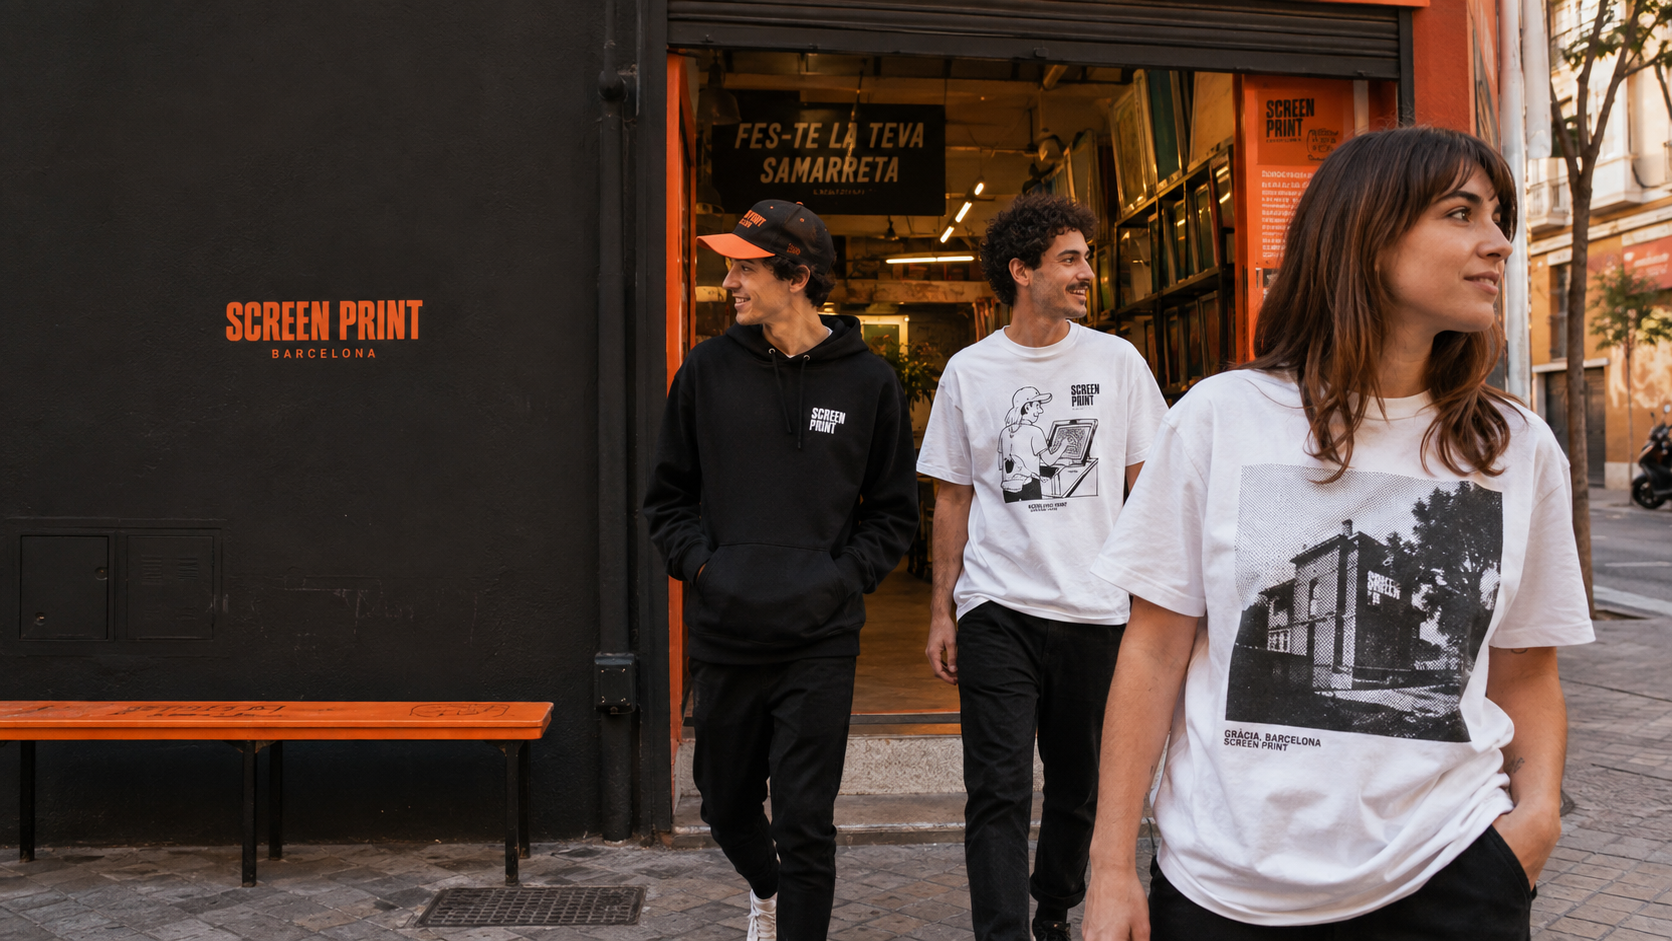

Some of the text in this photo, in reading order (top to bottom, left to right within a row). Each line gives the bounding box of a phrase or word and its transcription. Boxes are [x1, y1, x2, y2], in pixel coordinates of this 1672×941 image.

[1266, 98, 1315, 118] SCREEN
[734, 122, 924, 149] FES-TE LA TEVA
[1266, 118, 1304, 138] PRINT
[760, 156, 899, 183] SAMARRETA
[225, 300, 423, 342] SCREEN PRINT
[271, 348, 376, 359] BARCELONA
[1070, 384, 1100, 395] SCREEN
[1071, 395, 1094, 407] PRINT
[811, 407, 846, 425] SCREEN
[809, 419, 836, 434] PRINT
[1223, 738, 1289, 752] SCREEN PRINT
[1265, 733, 1322, 747] BARCELONA
